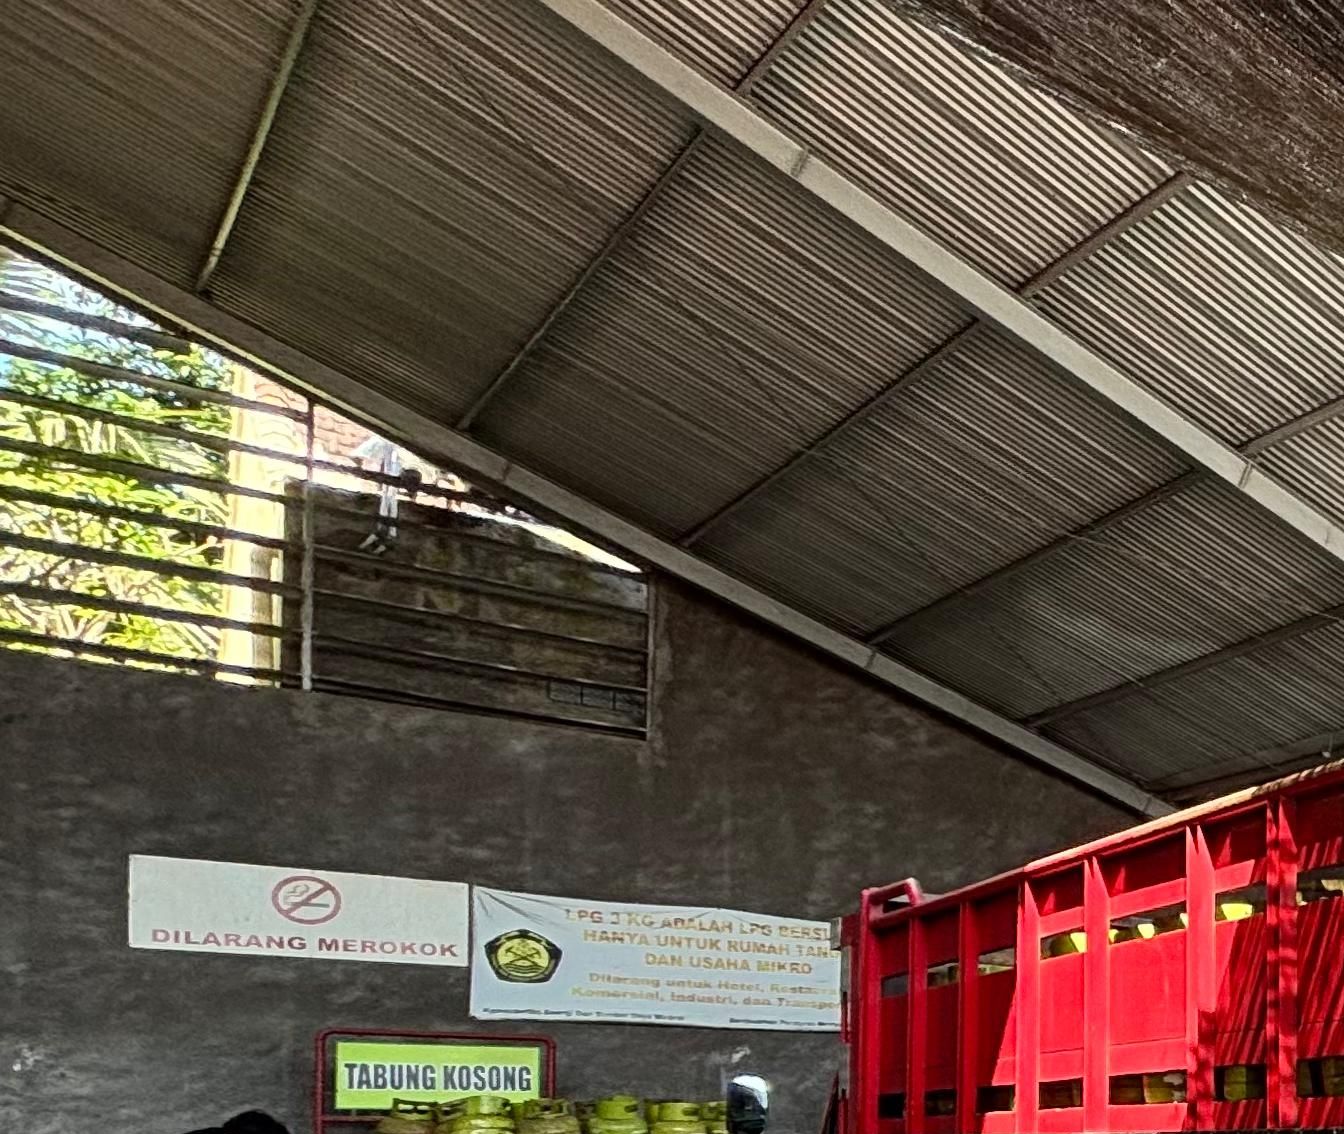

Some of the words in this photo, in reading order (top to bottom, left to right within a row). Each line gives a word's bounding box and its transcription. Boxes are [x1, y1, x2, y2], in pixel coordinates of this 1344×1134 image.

[626, 911, 655, 928] KG
[661, 917, 733, 934] ADALAH
[151, 928, 307, 951] DILARANG
[317, 937, 458, 958] MEROKOK
[583, 928, 650, 946] HANYA
[655, 934, 721, 952] UNTUK
[727, 940, 790, 956] RUMAH
[644, 952, 683, 967] DAN
[688, 957, 751, 972] USAHA
[756, 960, 813, 975] MIKRO
[344, 1063, 437, 1090] TABUNG
[443, 1065, 533, 1092] KOSONG
